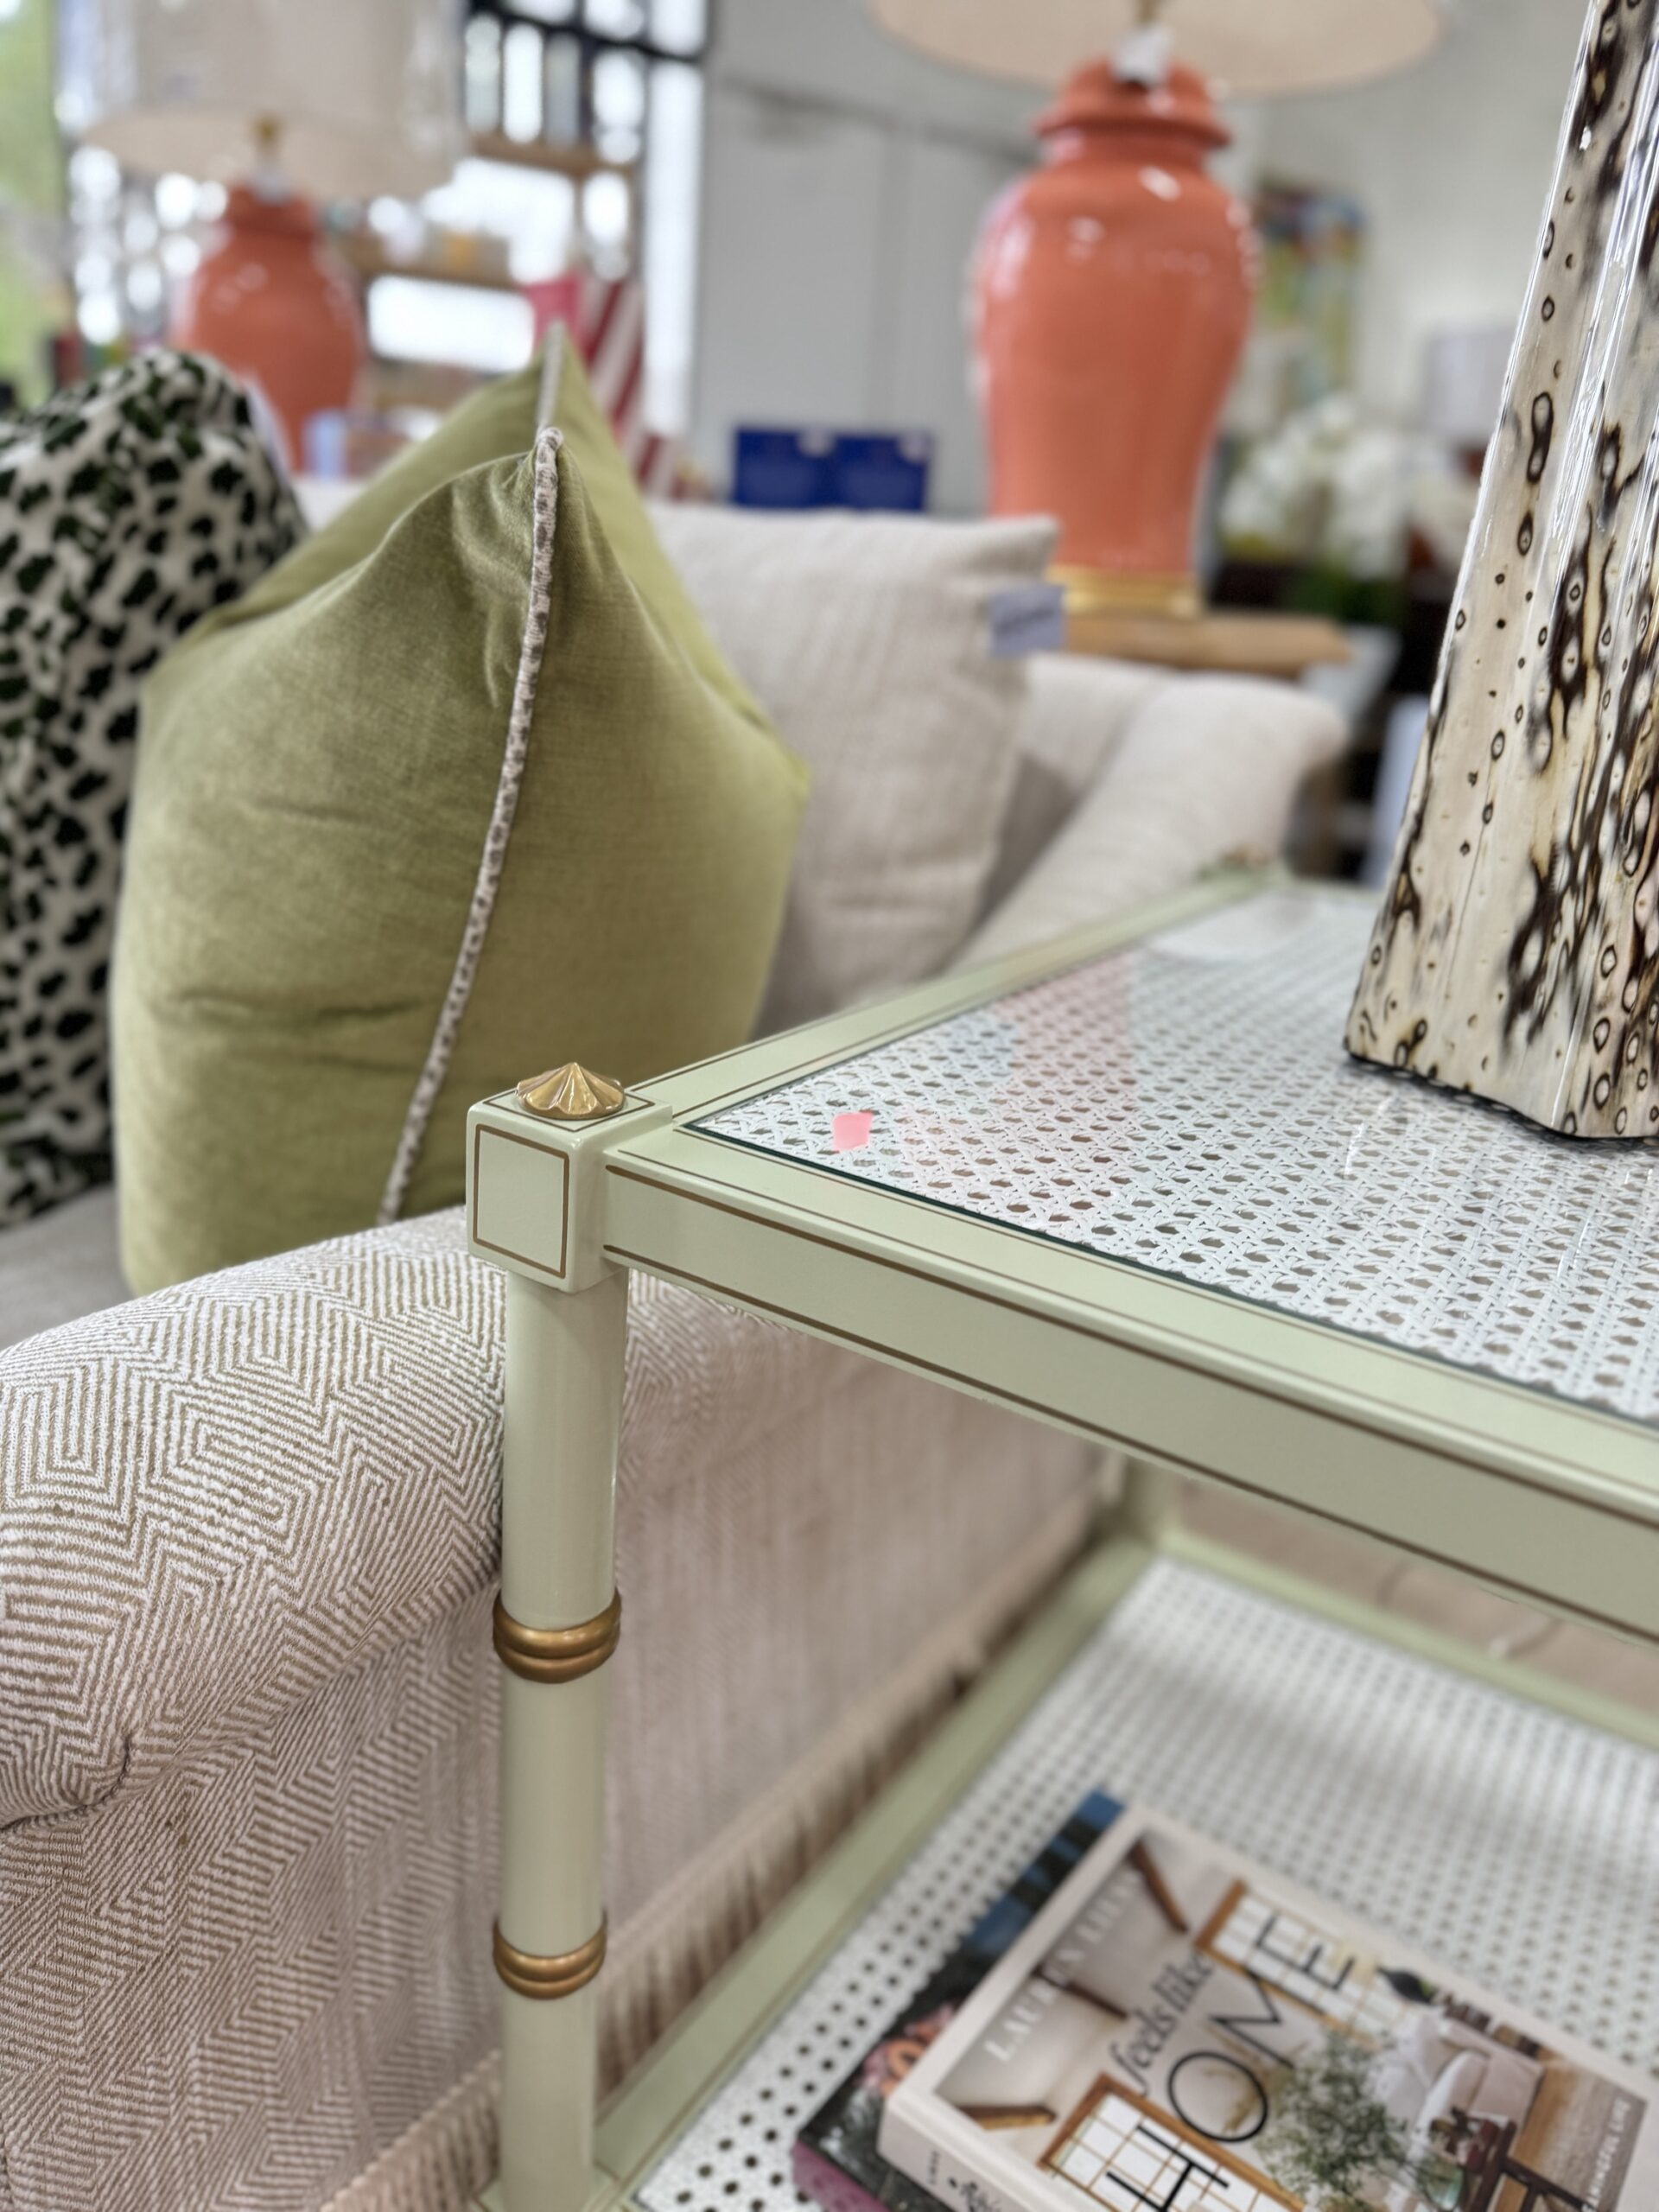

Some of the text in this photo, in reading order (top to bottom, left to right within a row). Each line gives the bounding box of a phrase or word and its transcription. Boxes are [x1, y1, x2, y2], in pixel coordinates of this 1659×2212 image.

[1105, 1914, 1357, 2211] HOME
[1109, 1950, 1213, 2097] feels like
